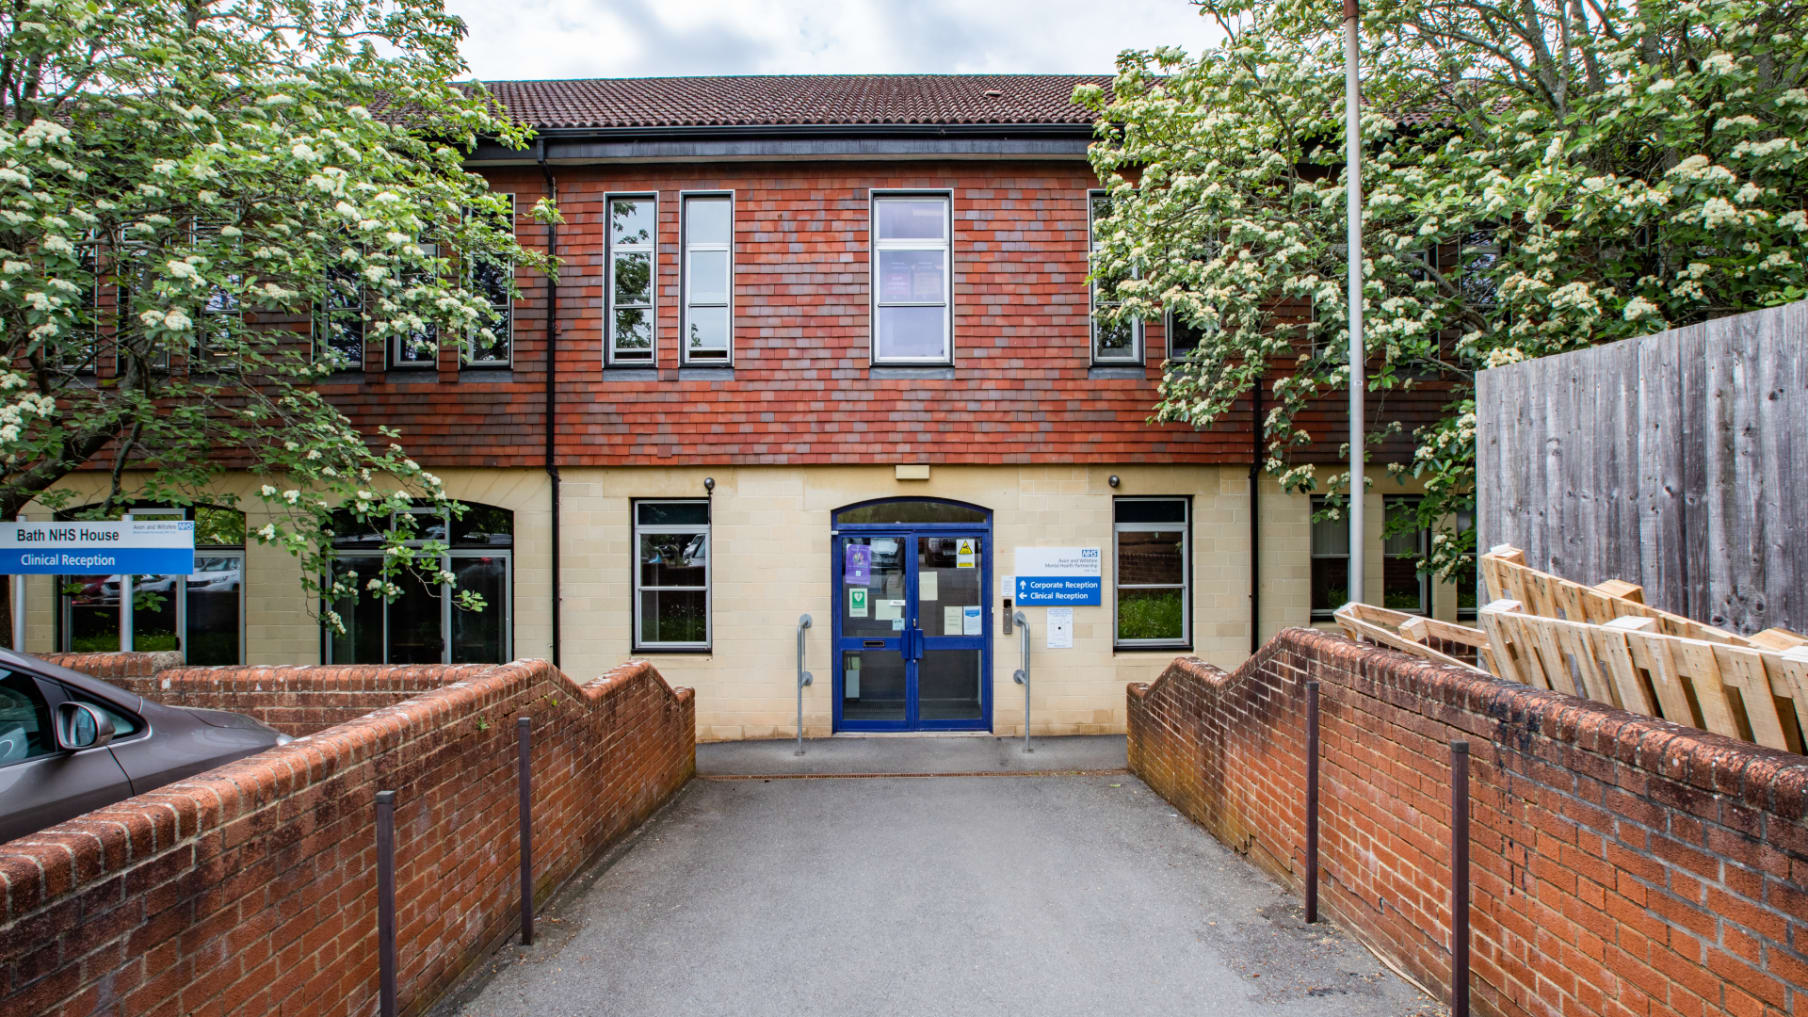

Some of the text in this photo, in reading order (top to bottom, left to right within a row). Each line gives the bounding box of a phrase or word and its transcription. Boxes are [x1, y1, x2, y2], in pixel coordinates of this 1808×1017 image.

[178, 522, 192, 530] NHS
[17, 528, 120, 541] Bath NHS House
[1082, 550, 1098, 558] NHS
[20, 554, 116, 568] Clinical Reception
[1030, 582, 1098, 590] Corporate Reception
[1056, 592, 1088, 600] Reception
